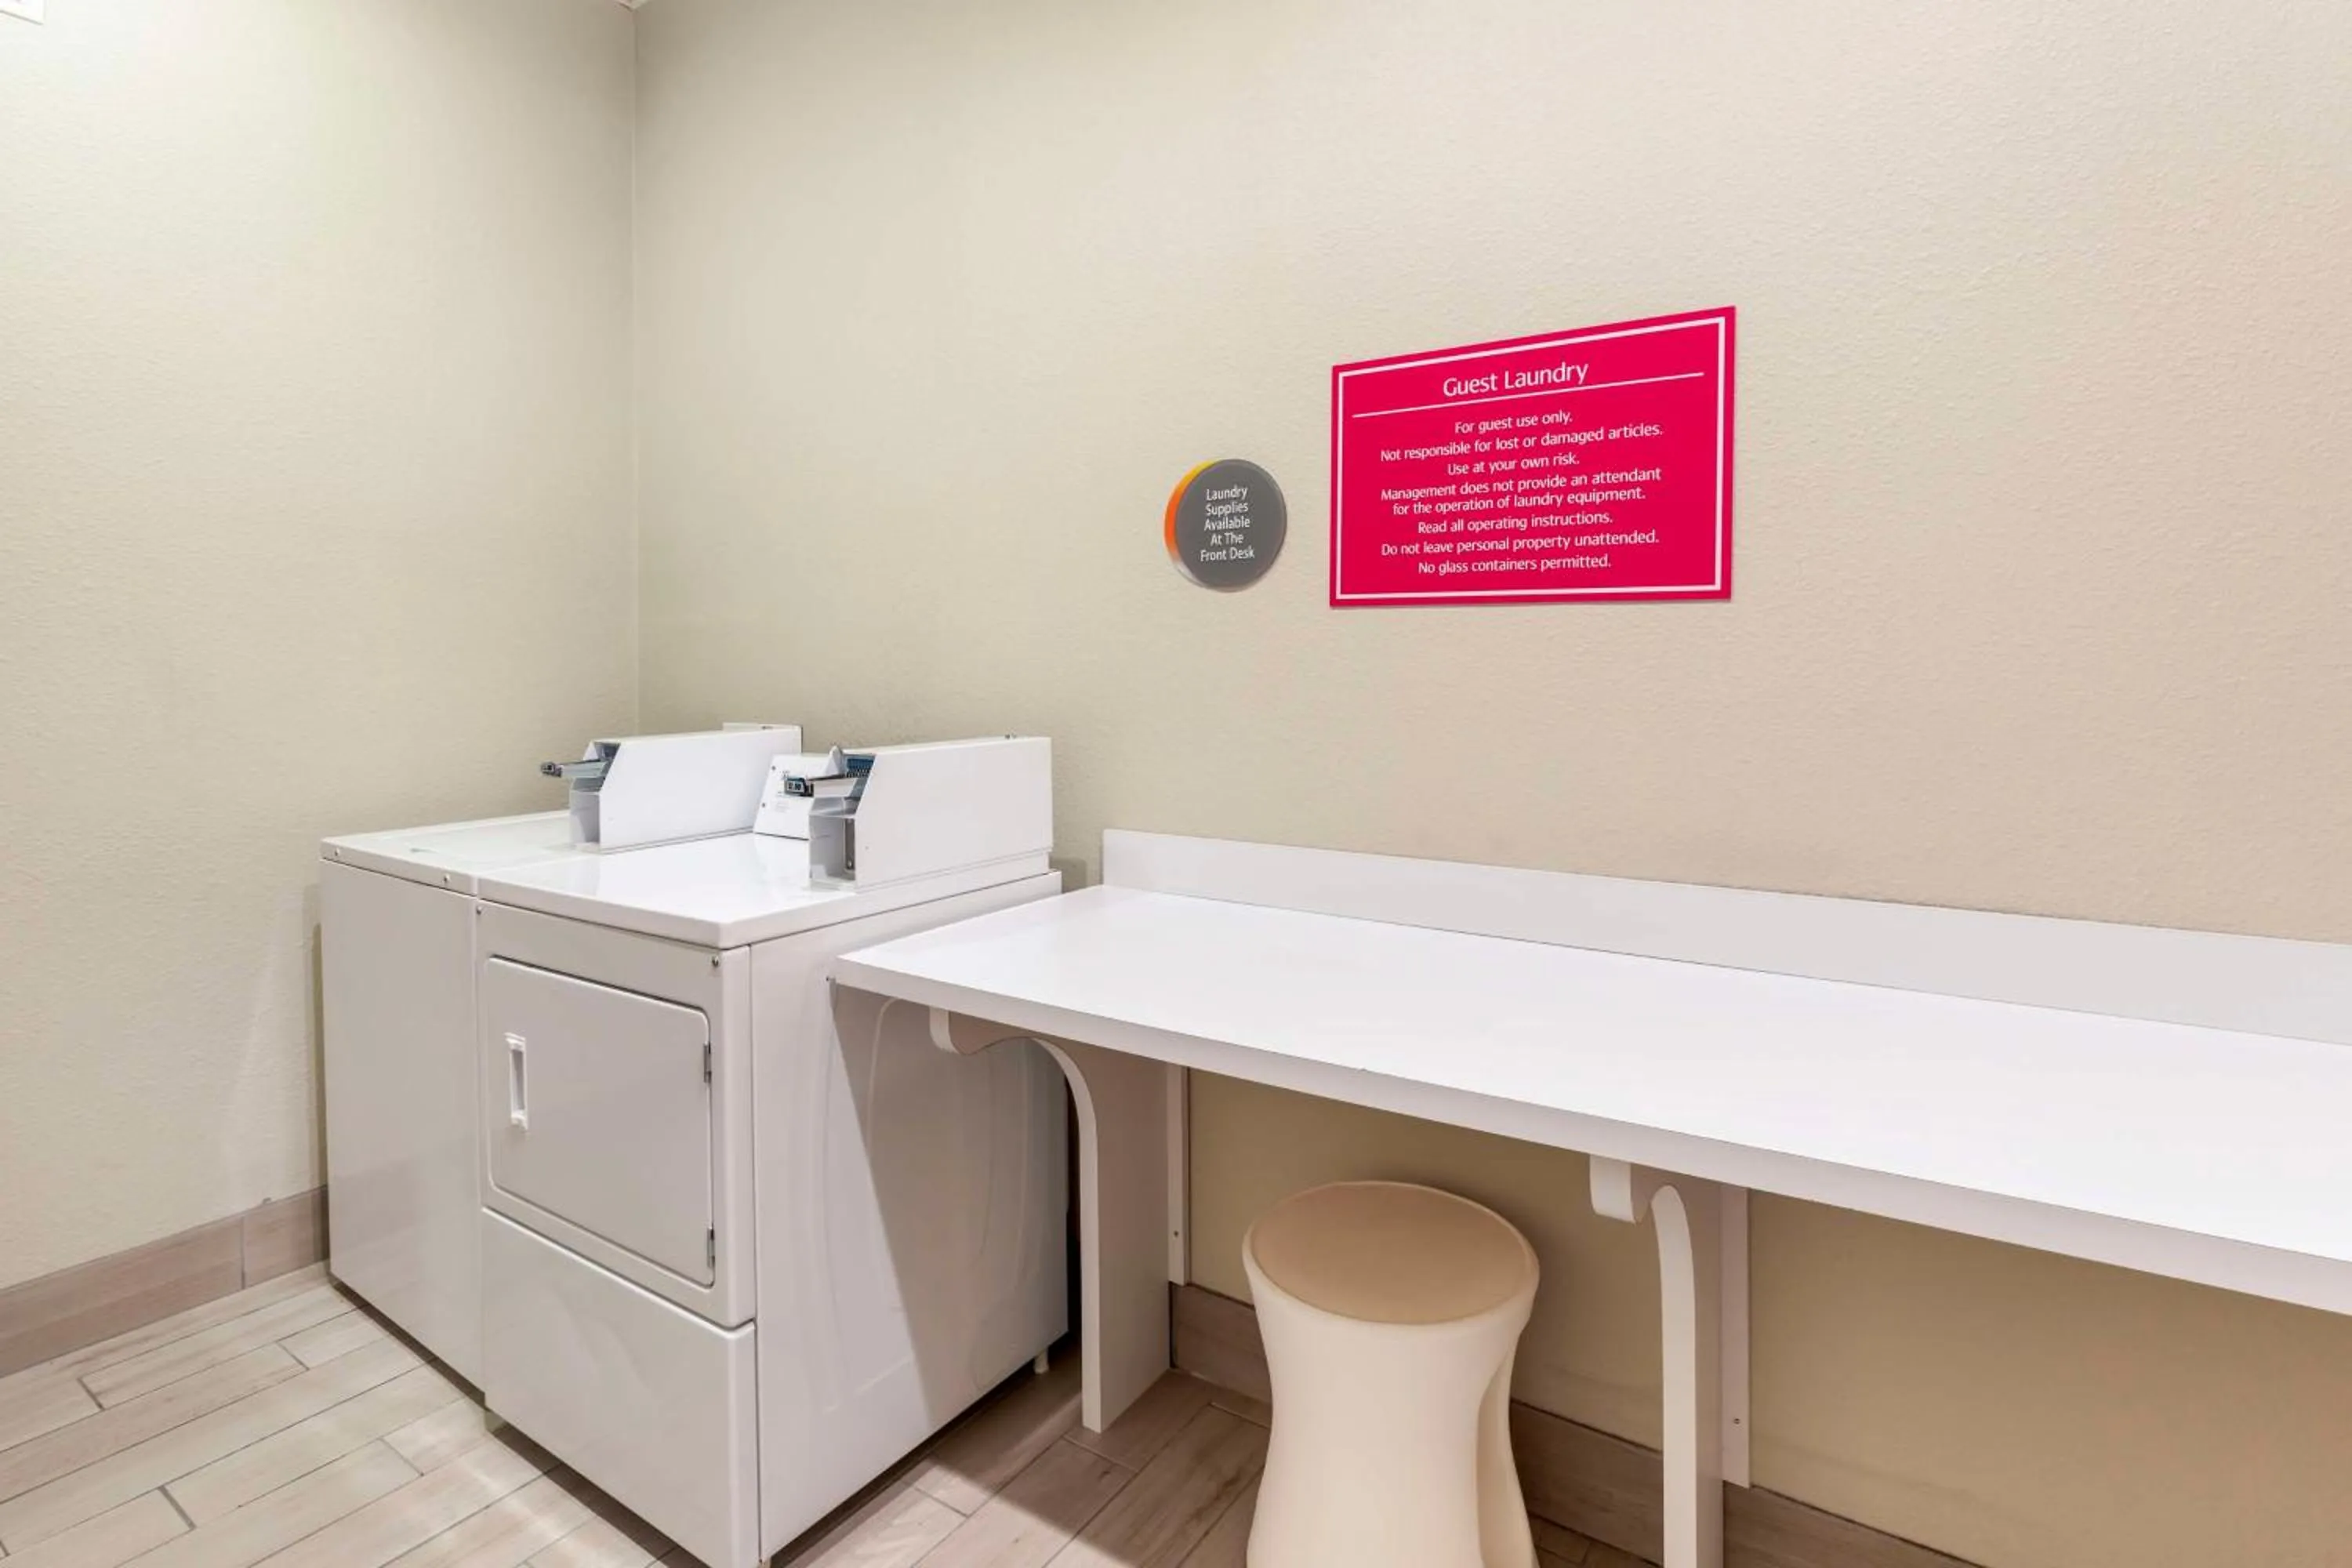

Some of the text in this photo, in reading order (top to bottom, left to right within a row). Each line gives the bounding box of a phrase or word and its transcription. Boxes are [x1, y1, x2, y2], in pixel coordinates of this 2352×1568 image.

[1443, 361, 1588, 397] Guest Laundry
[1455, 411, 1573, 434] For guest use only.
[1381, 422, 1664, 462] Not responsible for lost or damaged articles.
[1447, 452, 1580, 475] Use at your own risk.
[1206, 485, 1247, 501] Laundry
[1381, 467, 1661, 502] Management does not provide an attendant
[1206, 503, 1248, 517] Supplies
[1392, 486, 1646, 515] for the operation of laundry equipment.
[1204, 516, 1250, 531] Available
[1417, 511, 1613, 534] Read all operating instructions.
[1210, 532, 1243, 546] At The
[1381, 529, 1660, 556] Do not leave personal property unattended.
[1200, 546, 1254, 561] Front Desk
[1418, 554, 1612, 575] No glass containers permitted.
